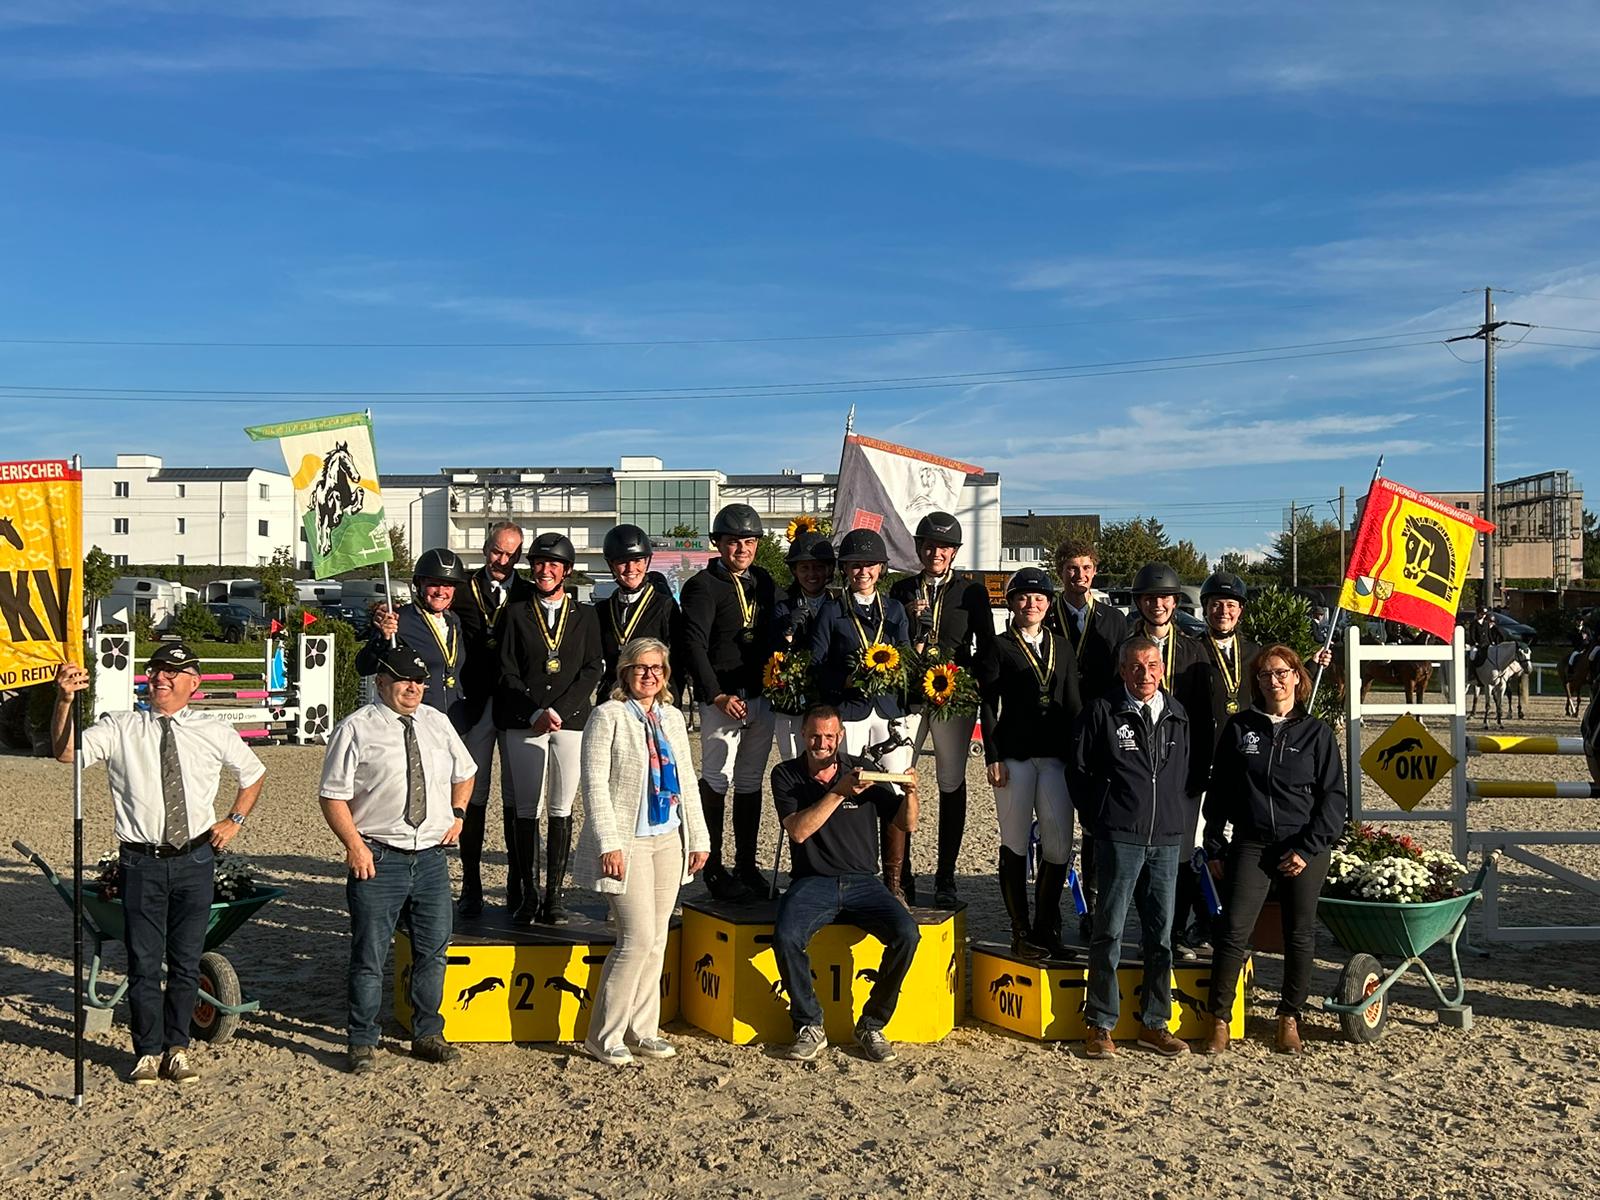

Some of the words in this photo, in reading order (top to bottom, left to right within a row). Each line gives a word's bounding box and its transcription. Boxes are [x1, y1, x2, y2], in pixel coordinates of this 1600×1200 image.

[0, 463, 65, 480] ERISCHER
[1396, 755, 1438, 780] OKV
[515, 972, 535, 1010] 2
[702, 970, 720, 1000] OKV
[829, 964, 841, 1002] 1
[999, 990, 1022, 1019] OKV
